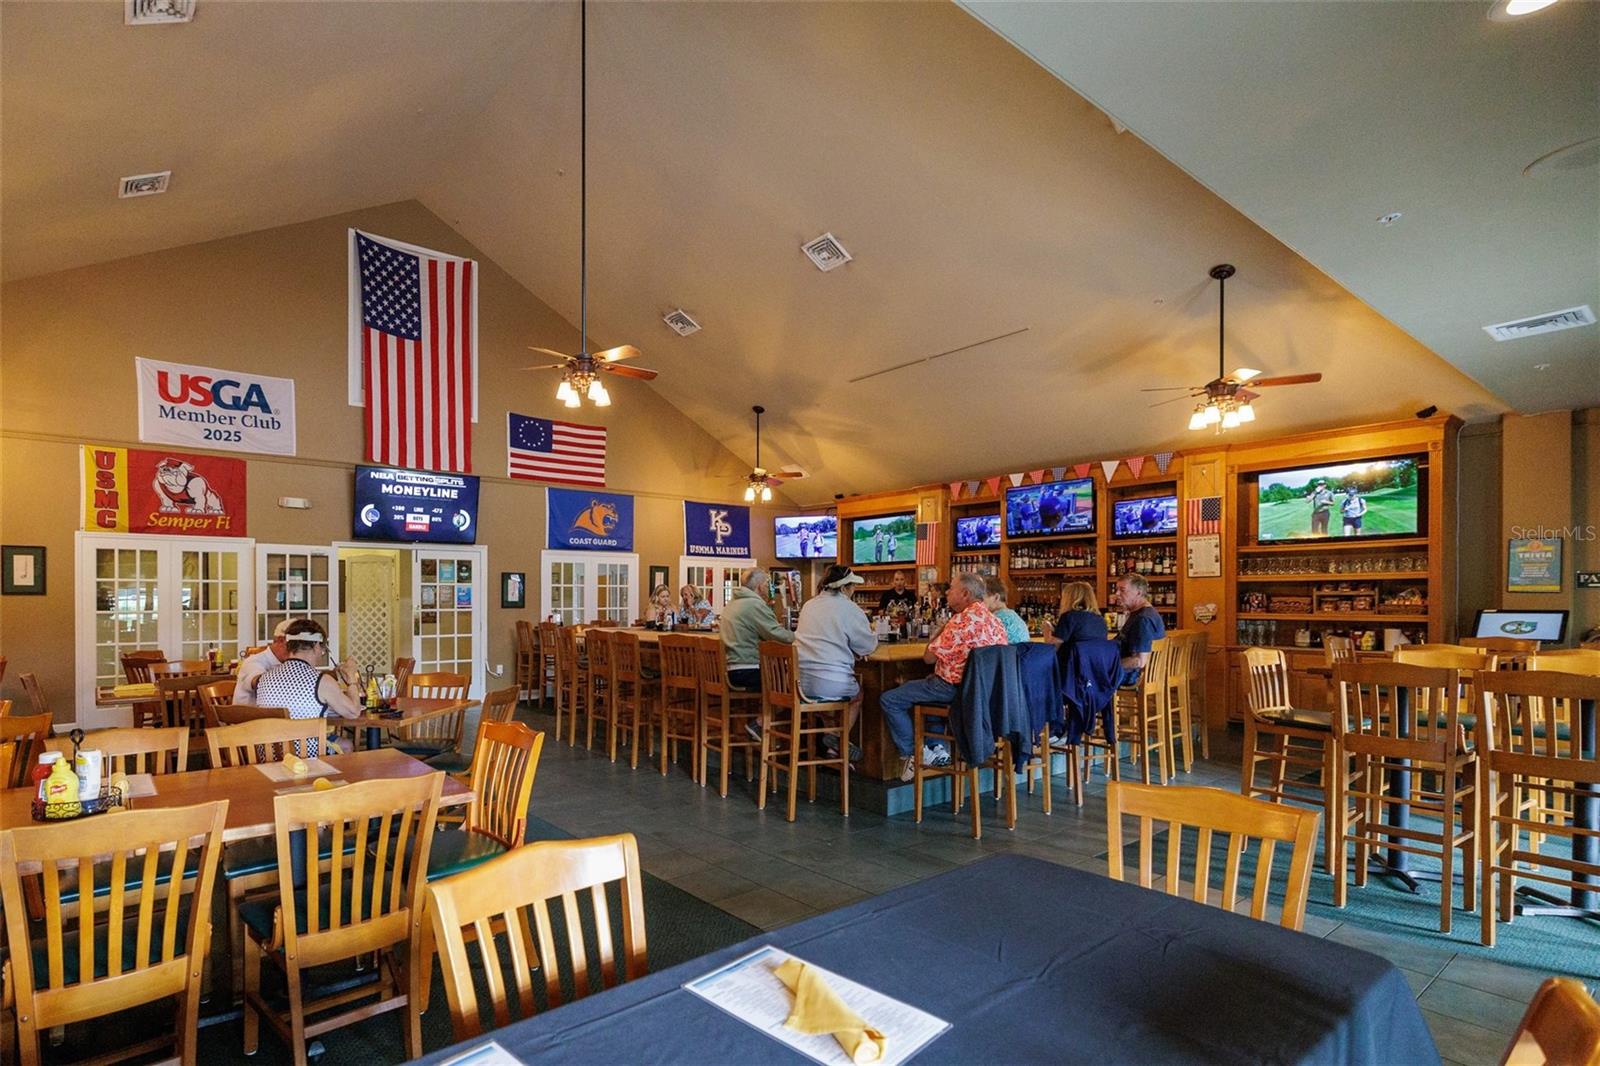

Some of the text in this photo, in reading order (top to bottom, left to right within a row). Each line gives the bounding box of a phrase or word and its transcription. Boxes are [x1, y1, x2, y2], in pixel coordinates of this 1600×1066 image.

[157, 371, 272, 414] USGA
[159, 405, 281, 431] Member Club
[203, 428, 242, 442] 2025
[370, 472, 395, 481] NBA
[397, 474, 434, 483] BETTING
[94, 450, 119, 528] USMC
[381, 484, 458, 499] MONEYLINE
[147, 512, 231, 530] Semper Fi
[709, 509, 732, 544] KP
[569, 537, 618, 546] COAST GUARD
[689, 545, 748, 555] USMMA MARINERS
[1518, 551, 1553, 559] TRIVIA
